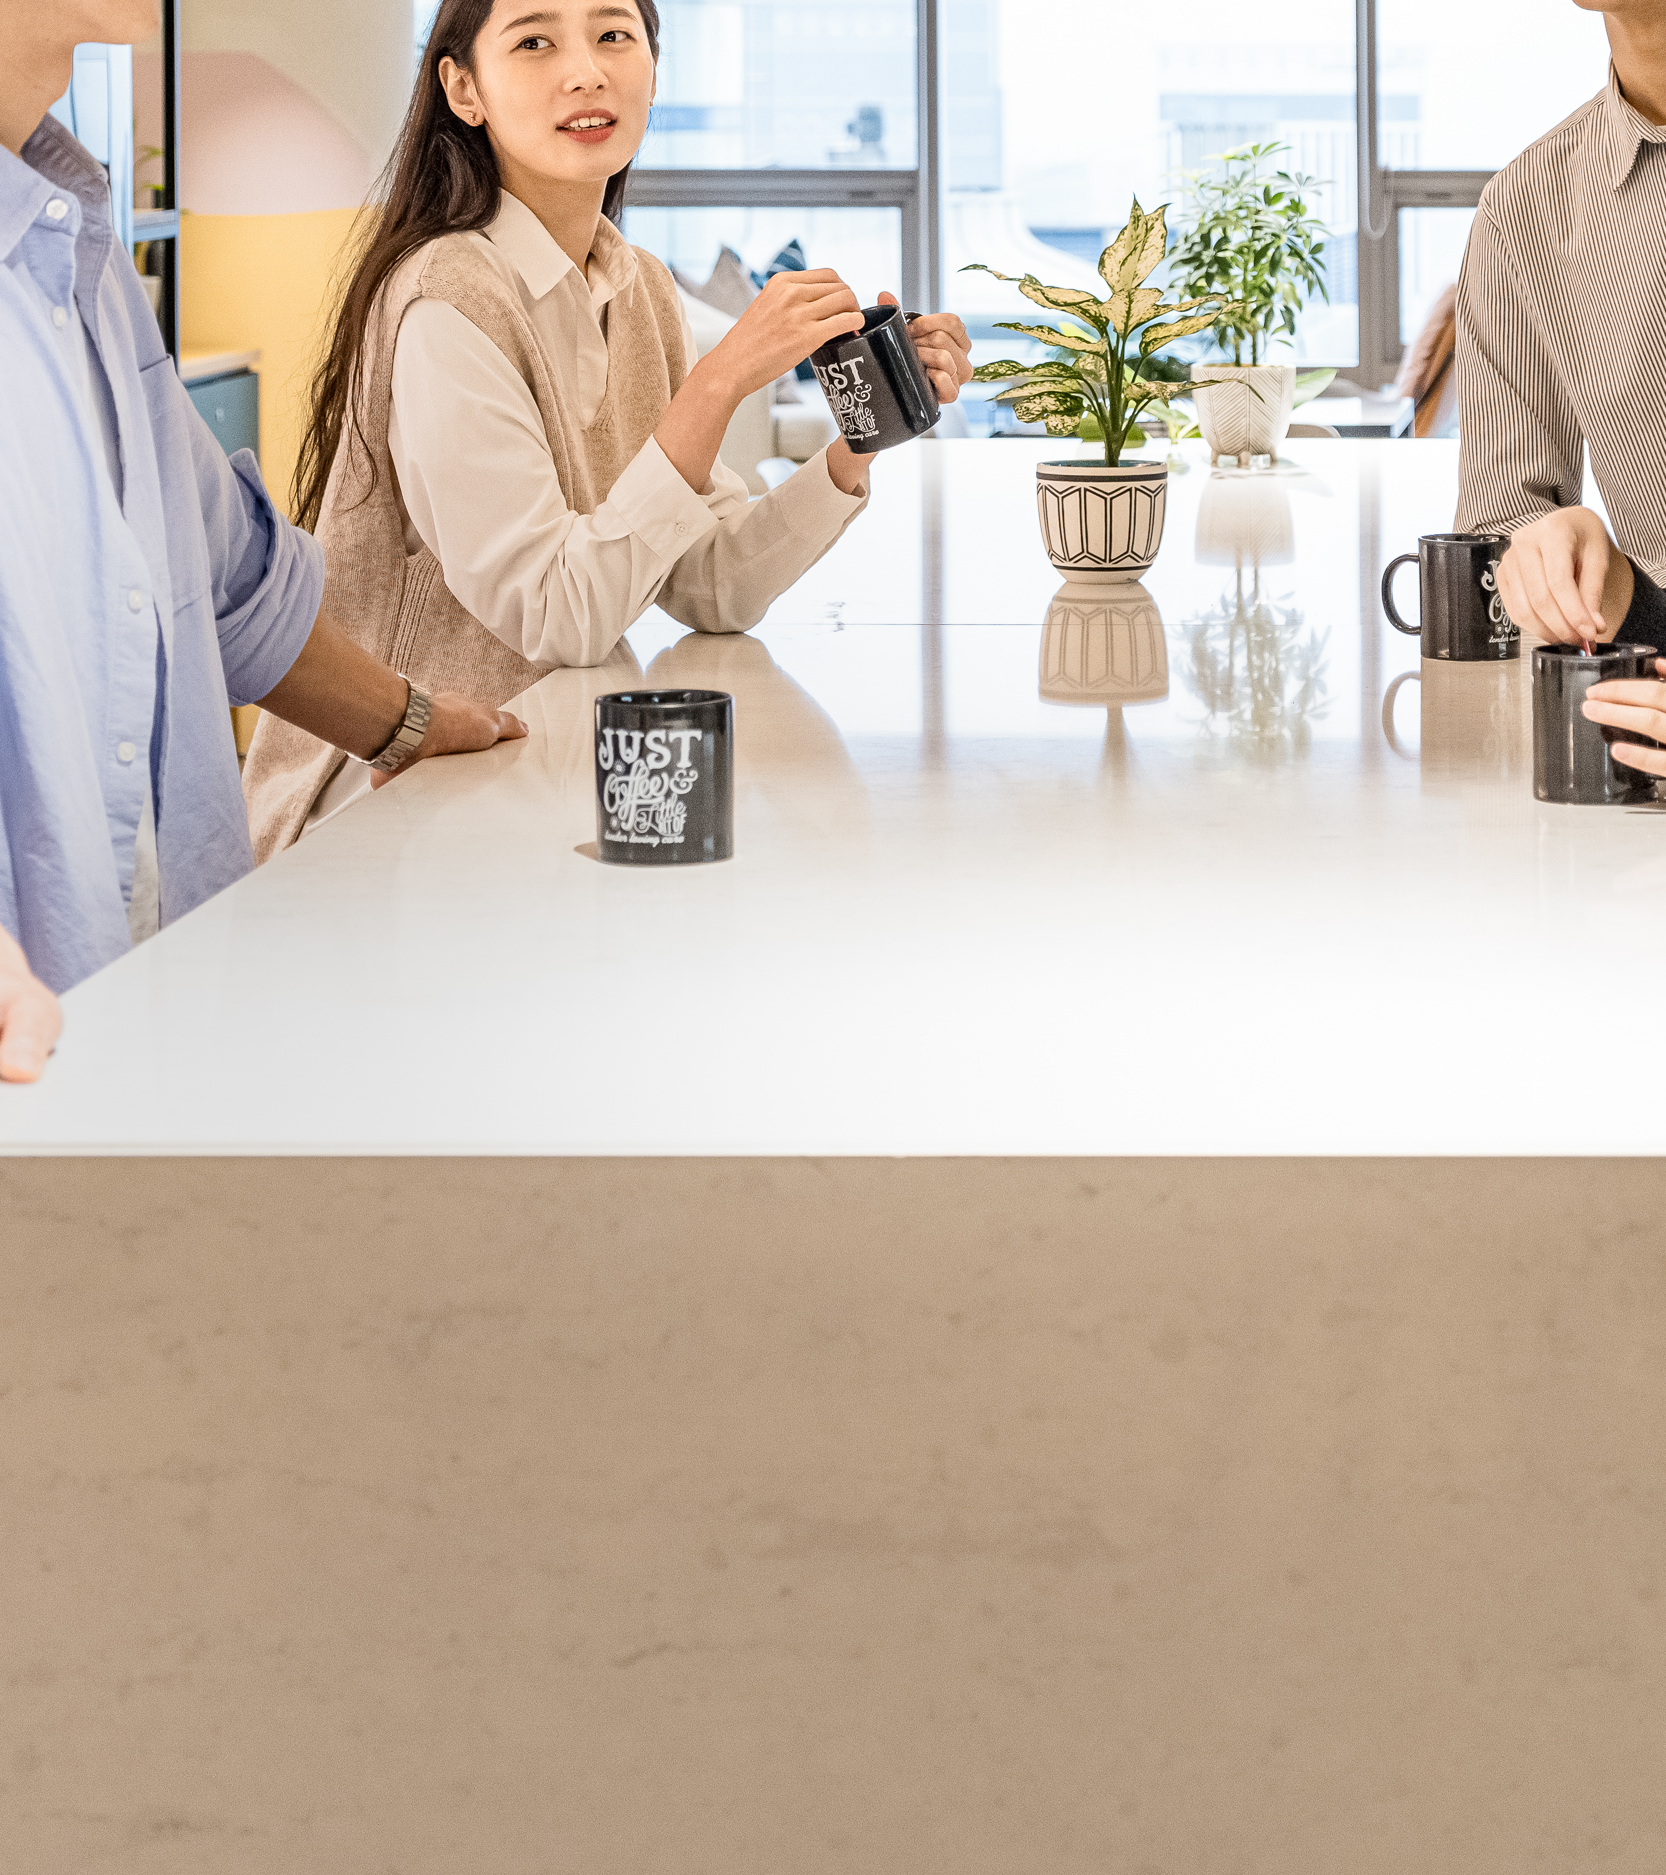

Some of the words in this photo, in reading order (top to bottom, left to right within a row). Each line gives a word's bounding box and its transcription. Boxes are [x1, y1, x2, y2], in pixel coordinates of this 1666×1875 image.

[814, 356, 864, 390] UST
[854, 384, 872, 402] &
[598, 727, 703, 770] JUST
[603, 759, 670, 831] Coffee
[669, 768, 699, 795] &
[634, 793, 687, 836] Little
